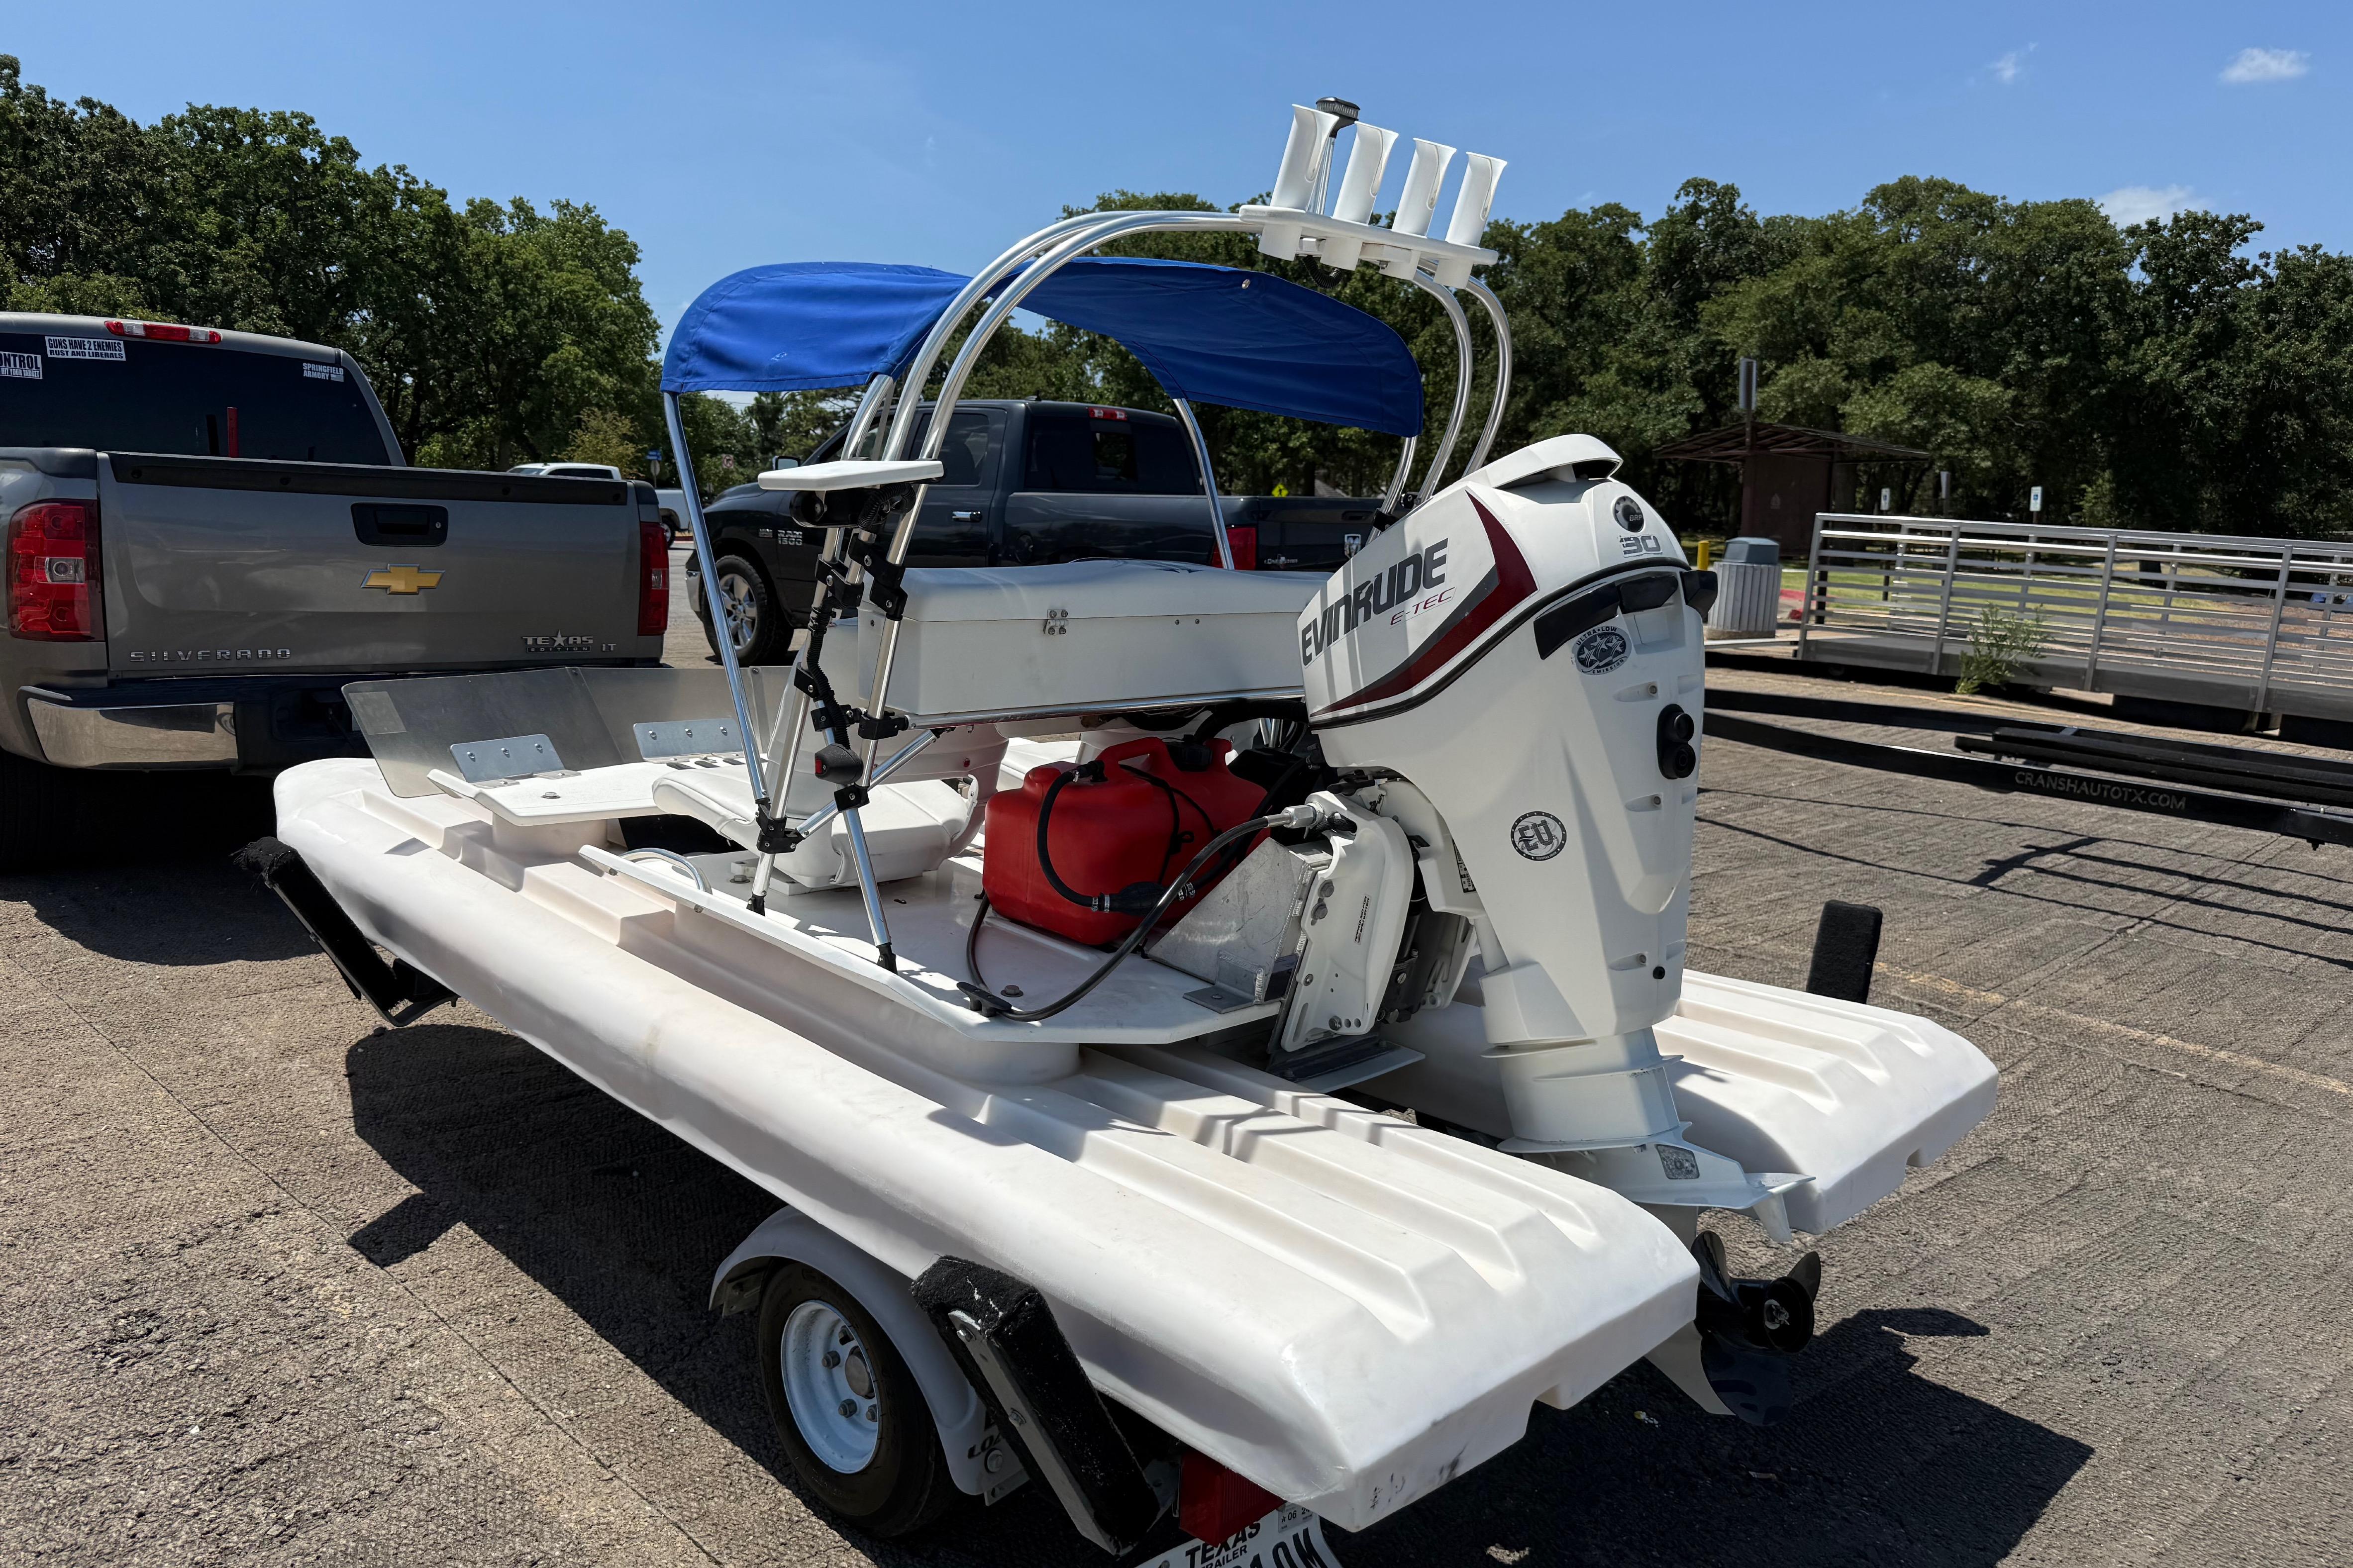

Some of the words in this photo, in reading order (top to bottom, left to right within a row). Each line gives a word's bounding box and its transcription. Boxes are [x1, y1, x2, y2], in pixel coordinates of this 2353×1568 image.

[48, 338, 67, 349] GUNS
[69, 340, 86, 351] HAVE
[87, 340, 92, 351] 2
[93, 341, 122, 352] ENEMIES
[303, 363, 343, 375] SPRINGFIELD
[304, 370, 329, 380] ARMORY
[778, 530, 803, 538] RAM
[778, 537, 803, 546] 1500
[1619, 535, 1661, 555] 30
[1301, 537, 1448, 667] EVINRUDE
[1390, 587, 1455, 626] E-TEC
[130, 648, 291, 662] SILVERADO
[2015, 771, 2187, 810] CRANSHAUTOTX.COM
[1288, 1510, 1297, 1521] 06
